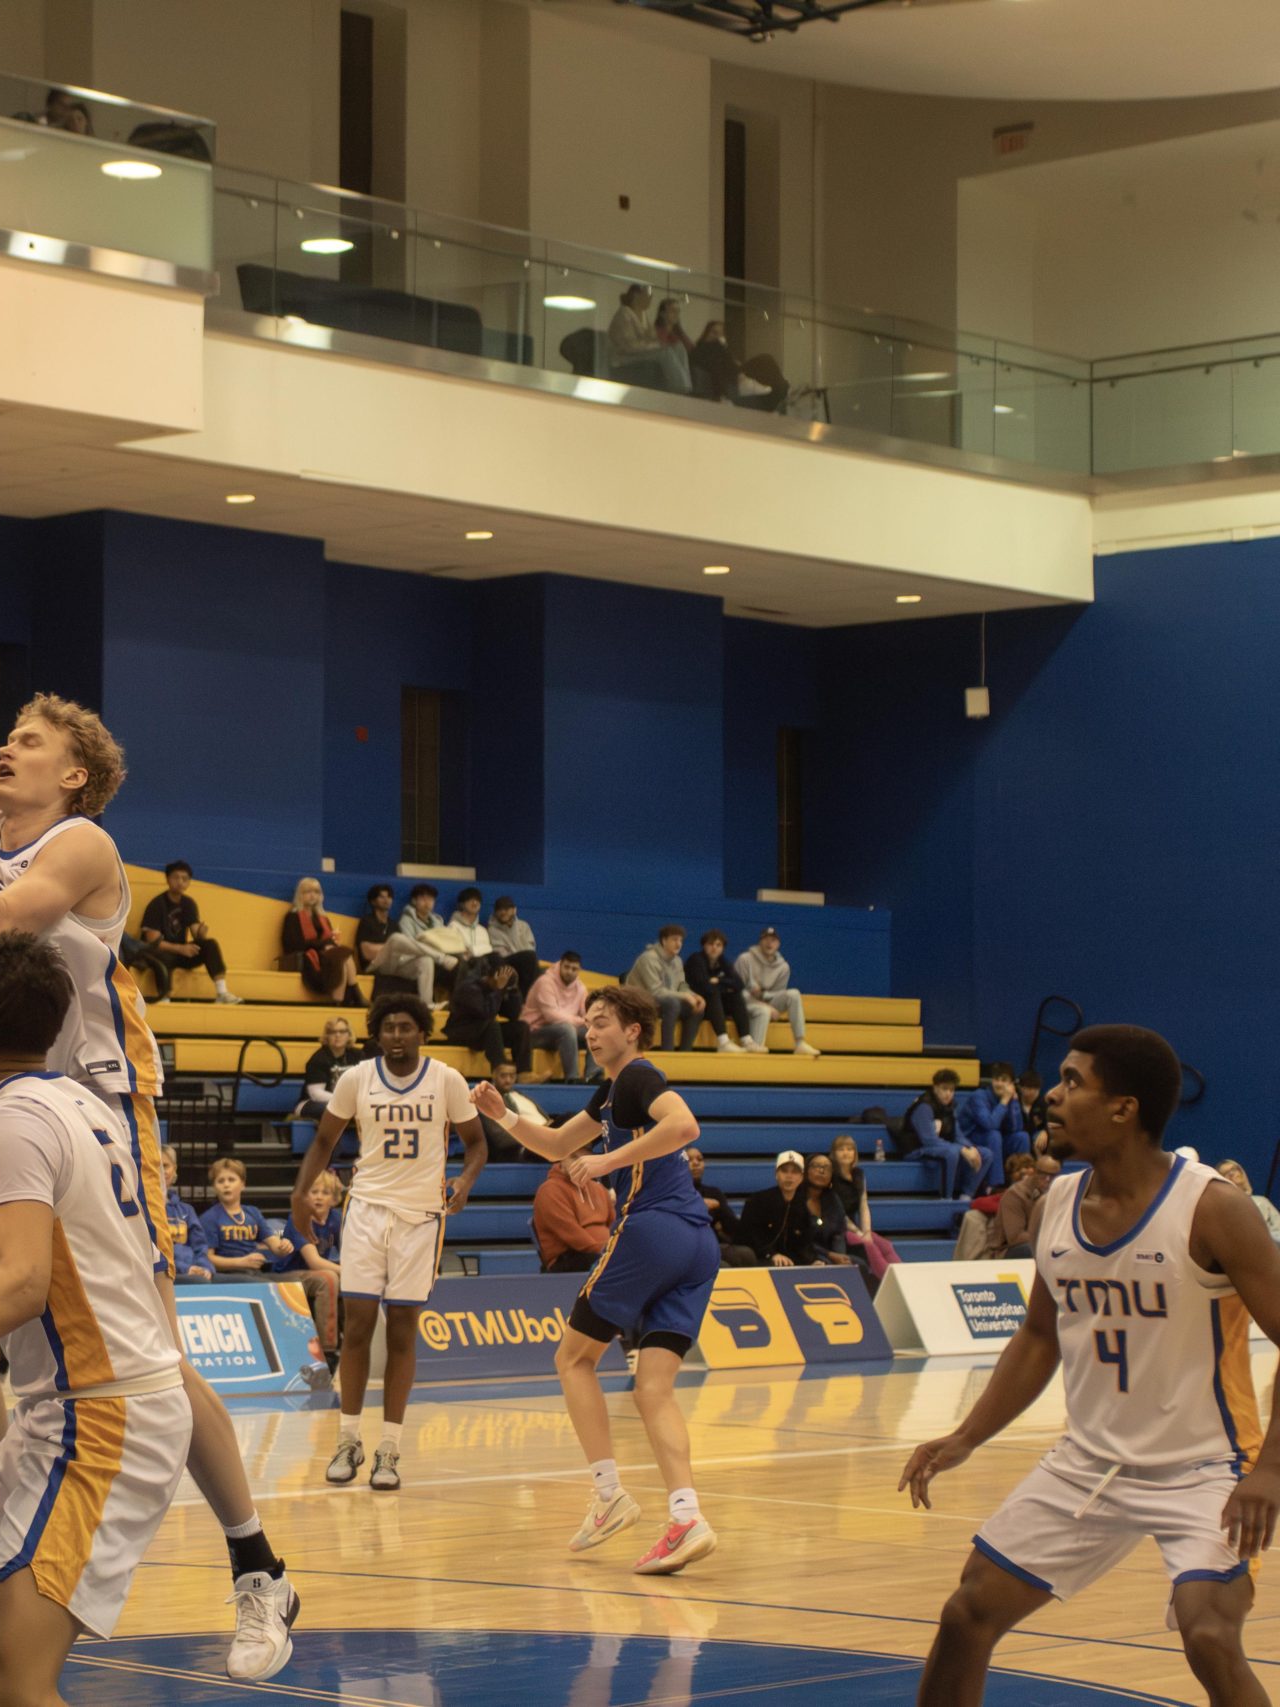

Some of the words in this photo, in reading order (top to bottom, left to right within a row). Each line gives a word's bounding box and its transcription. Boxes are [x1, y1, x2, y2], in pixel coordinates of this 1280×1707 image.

[370, 1104, 433, 1122] TMU
[383, 1128, 419, 1159] 23
[221, 1223, 259, 1241] TMU
[1056, 1277, 1169, 1319] TMU
[418, 1307, 571, 1351] @TMUbol
[191, 1355, 257, 1367] RATION
[1093, 1328, 1130, 1393] 4
